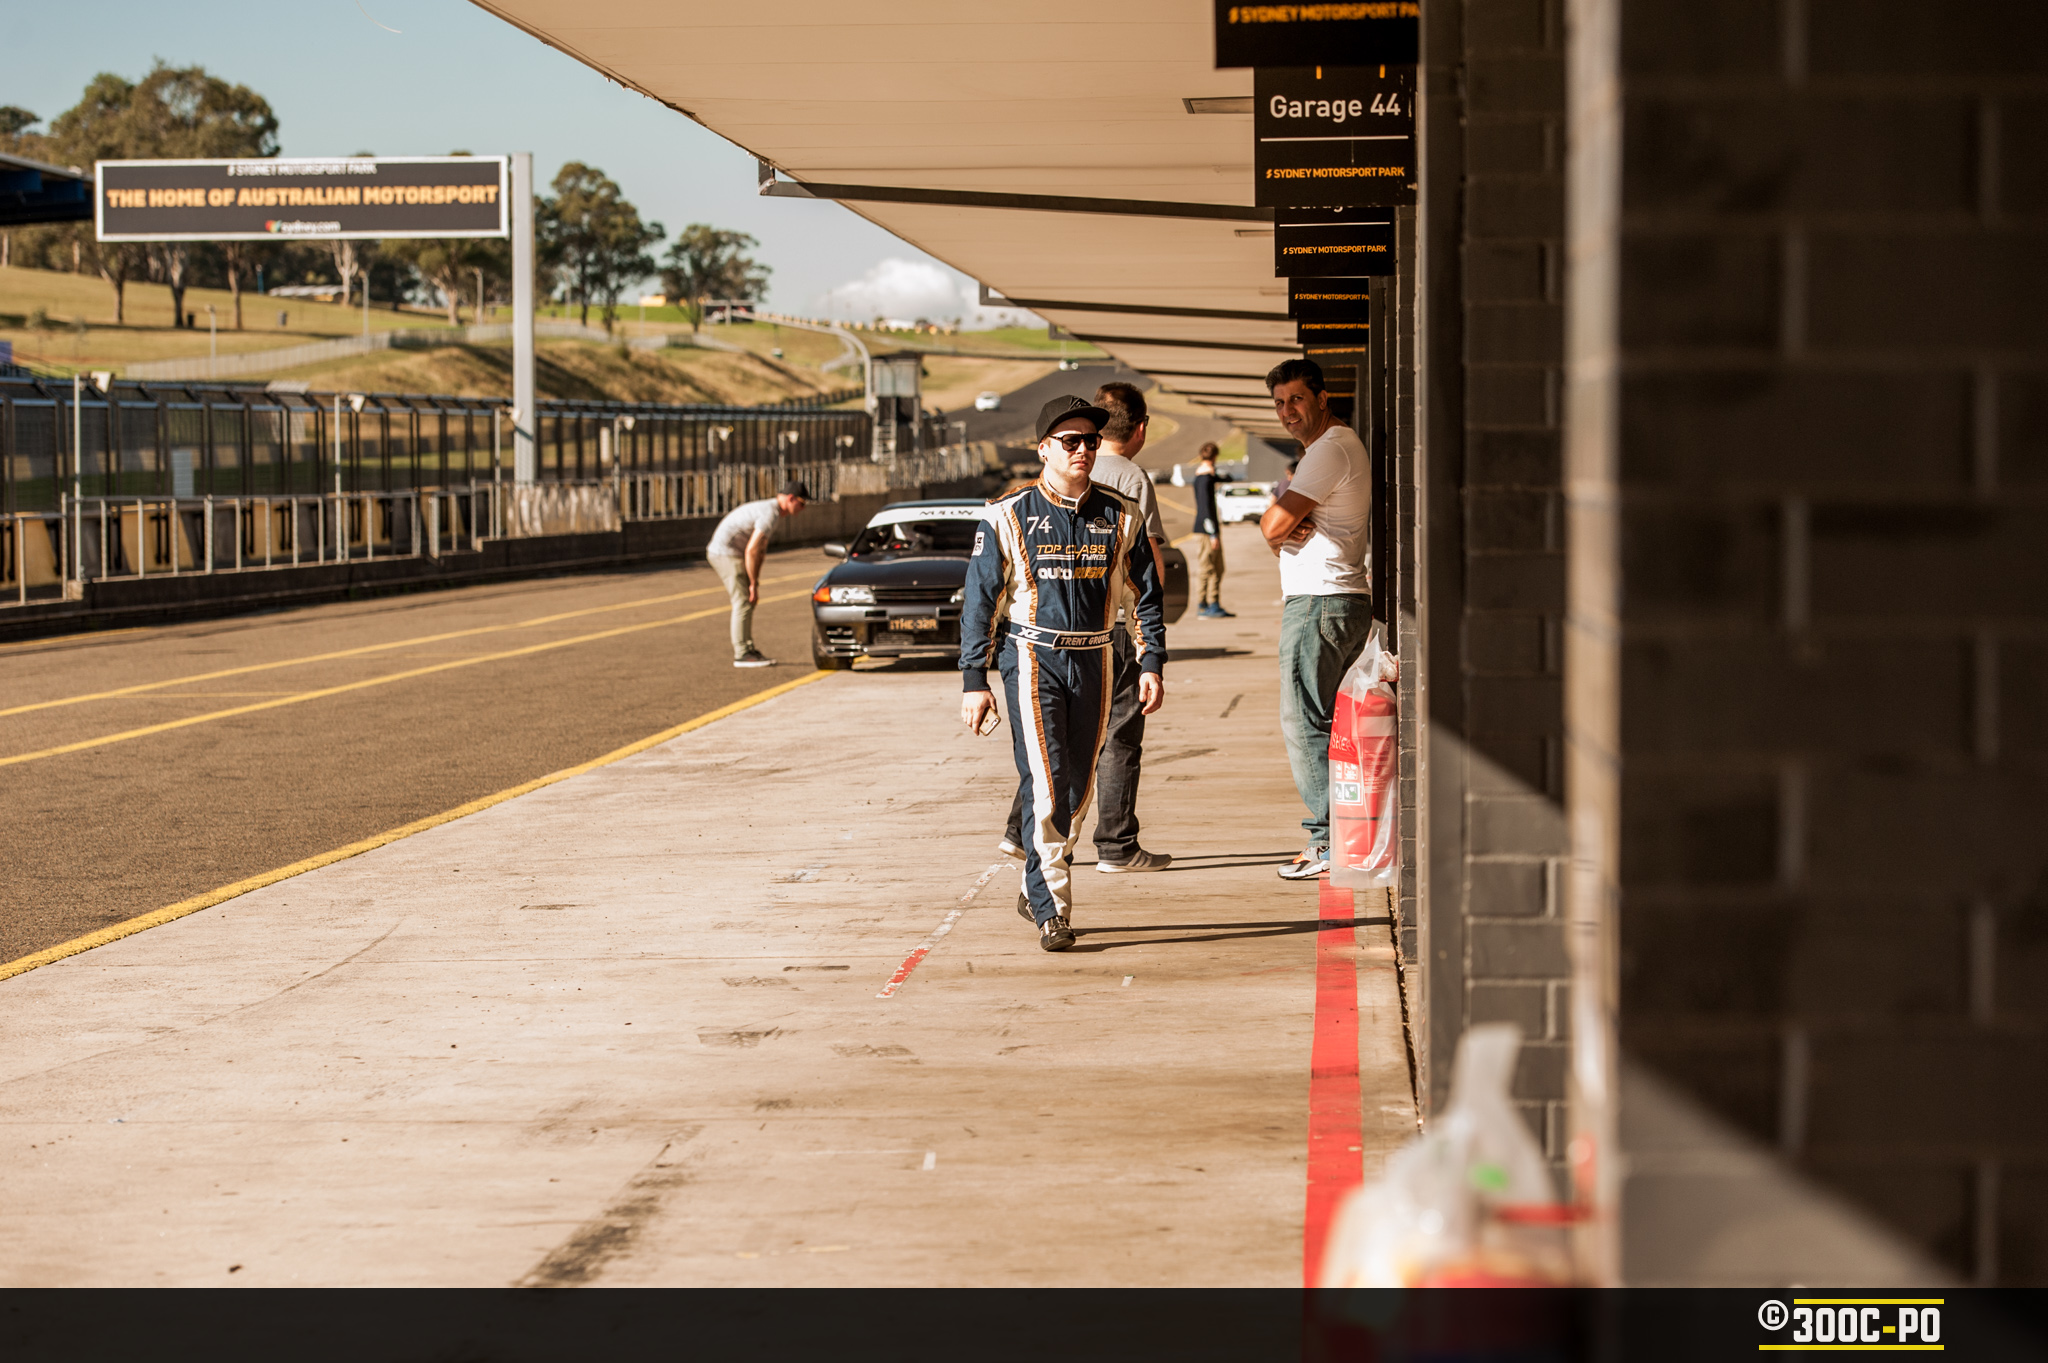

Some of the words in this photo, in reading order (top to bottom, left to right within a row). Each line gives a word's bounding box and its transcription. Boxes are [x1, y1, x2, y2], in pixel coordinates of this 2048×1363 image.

[1270, 95, 1362, 123] Garage
[1370, 93, 1401, 116] 44
[1274, 168, 1312, 179] SYDNEY
[1313, 167, 1377, 178] MOTORSPORT
[1379, 166, 1404, 177] PARK
[106, 189, 147, 208] THE
[149, 188, 206, 207] HOME
[208, 187, 236, 207] OF
[237, 186, 361, 207] AUSTRALIAN
[363, 185, 498, 205] MOTORSPORT
[281, 220, 342, 233] sydney.com
[1318, 245, 1366, 254] MOTORSPORT
[1026, 515, 1053, 535] 74
[1036, 544, 1062, 555] TOP
[1065, 544, 1107, 558] CLASS
[1060, 637, 1088, 646] TRENT
